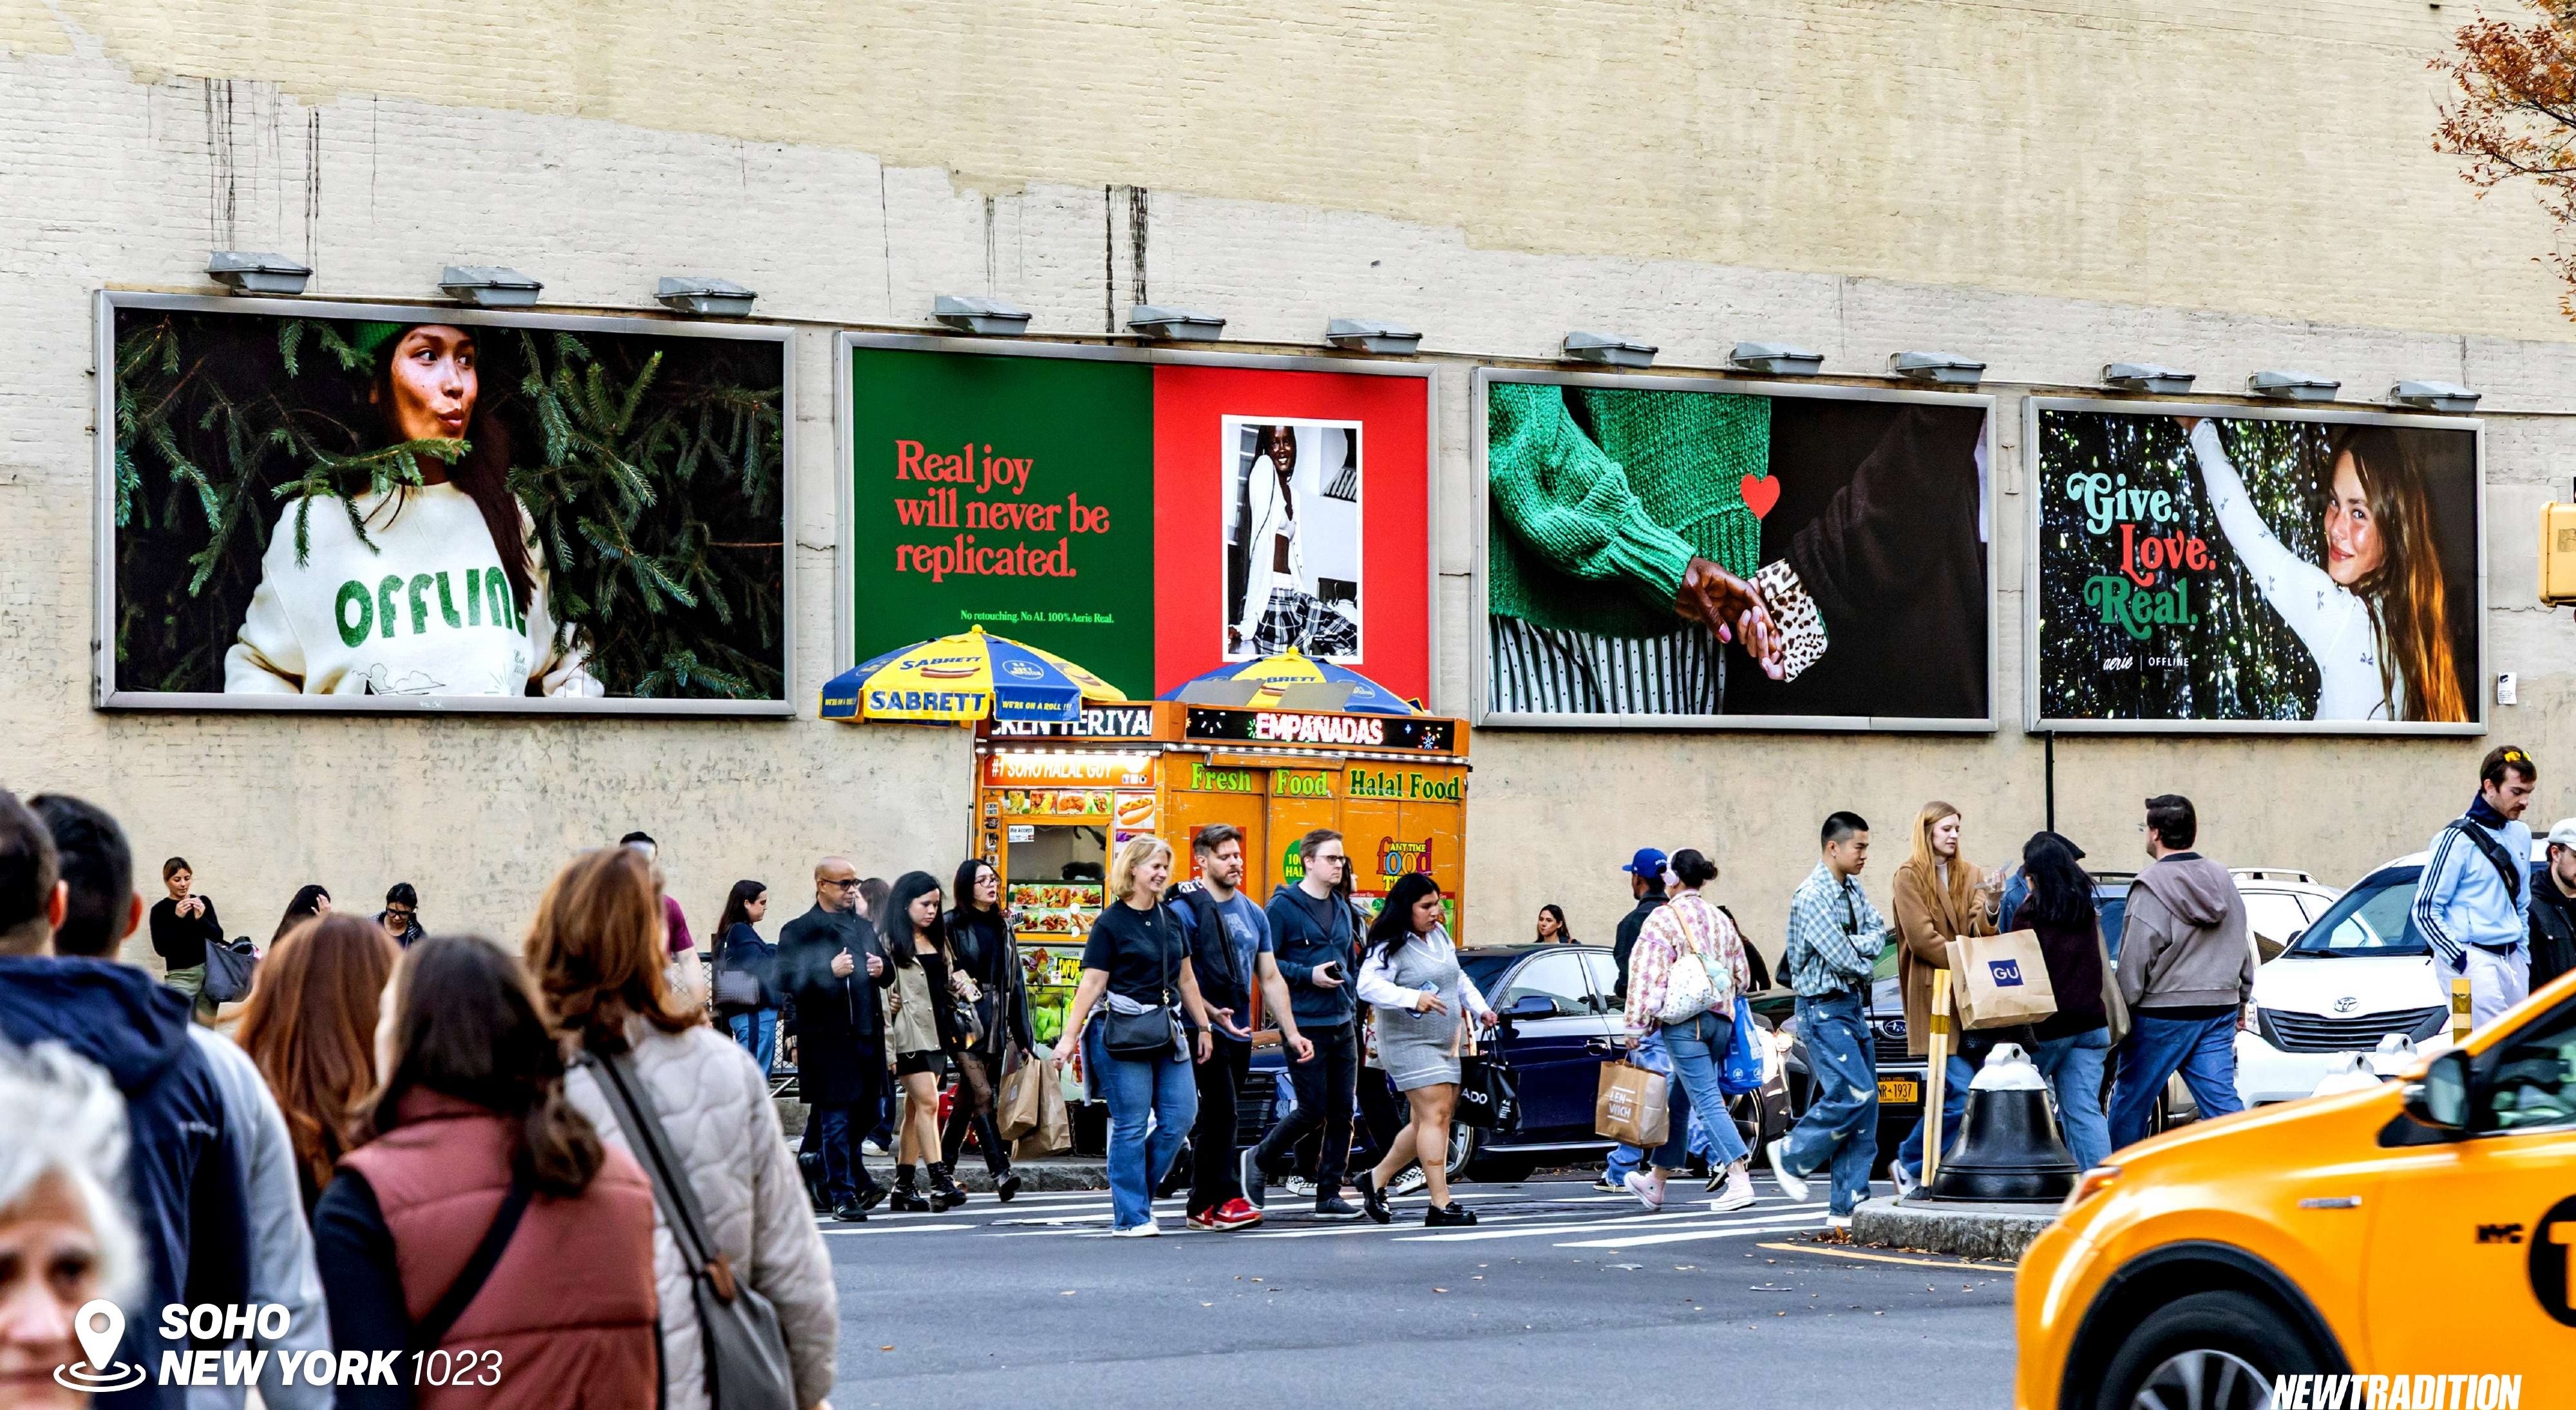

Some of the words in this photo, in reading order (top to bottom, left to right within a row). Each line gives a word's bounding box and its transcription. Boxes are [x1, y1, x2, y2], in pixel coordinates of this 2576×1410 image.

[895, 440, 975, 482] Real
[976, 444, 1034, 495] joy
[895, 487, 959, 527] will
[965, 501, 1062, 531] never
[1068, 492, 1110, 533] be
[2067, 473, 2180, 534] Give.
[895, 534, 1077, 583] replicated.
[2119, 523, 2216, 587] Love.
[961, 610, 972, 619] No
[974, 611, 1019, 623] retouching.
[1021, 611, 1032, 621] No
[1033, 612, 1045, 621] AI.
[1048, 612, 1070, 622] 100%
[1072, 613, 1092, 623] Aerie
[1094, 614, 1114, 623] Real.
[2083, 576, 2198, 639] Real.
[900, 657, 982, 670] SABRETT
[2103, 652, 2133, 670] aerie
[2148, 657, 2189, 666] OFFLINE
[869, 690, 985, 711] SABRETT
[1002, 701, 1024, 710] WE'RE
[1037, 702, 1042, 710] A
[1044, 702, 1061, 711] ROLL
[1256, 712, 1383, 745] EMPANADAS
[1043, 761, 1083, 779] HALAL
[1086, 762, 1113, 778] GUY
[1190, 762, 1252, 791] Fresh
[1276, 768, 1327, 796] Food
[1350, 769, 1403, 798] Halal
[1410, 773, 1460, 800] Food
[1376, 836, 1432, 876] food
[1993, 966, 2019, 980] GU
[1894, 1084, 1912, 1098] 1937
